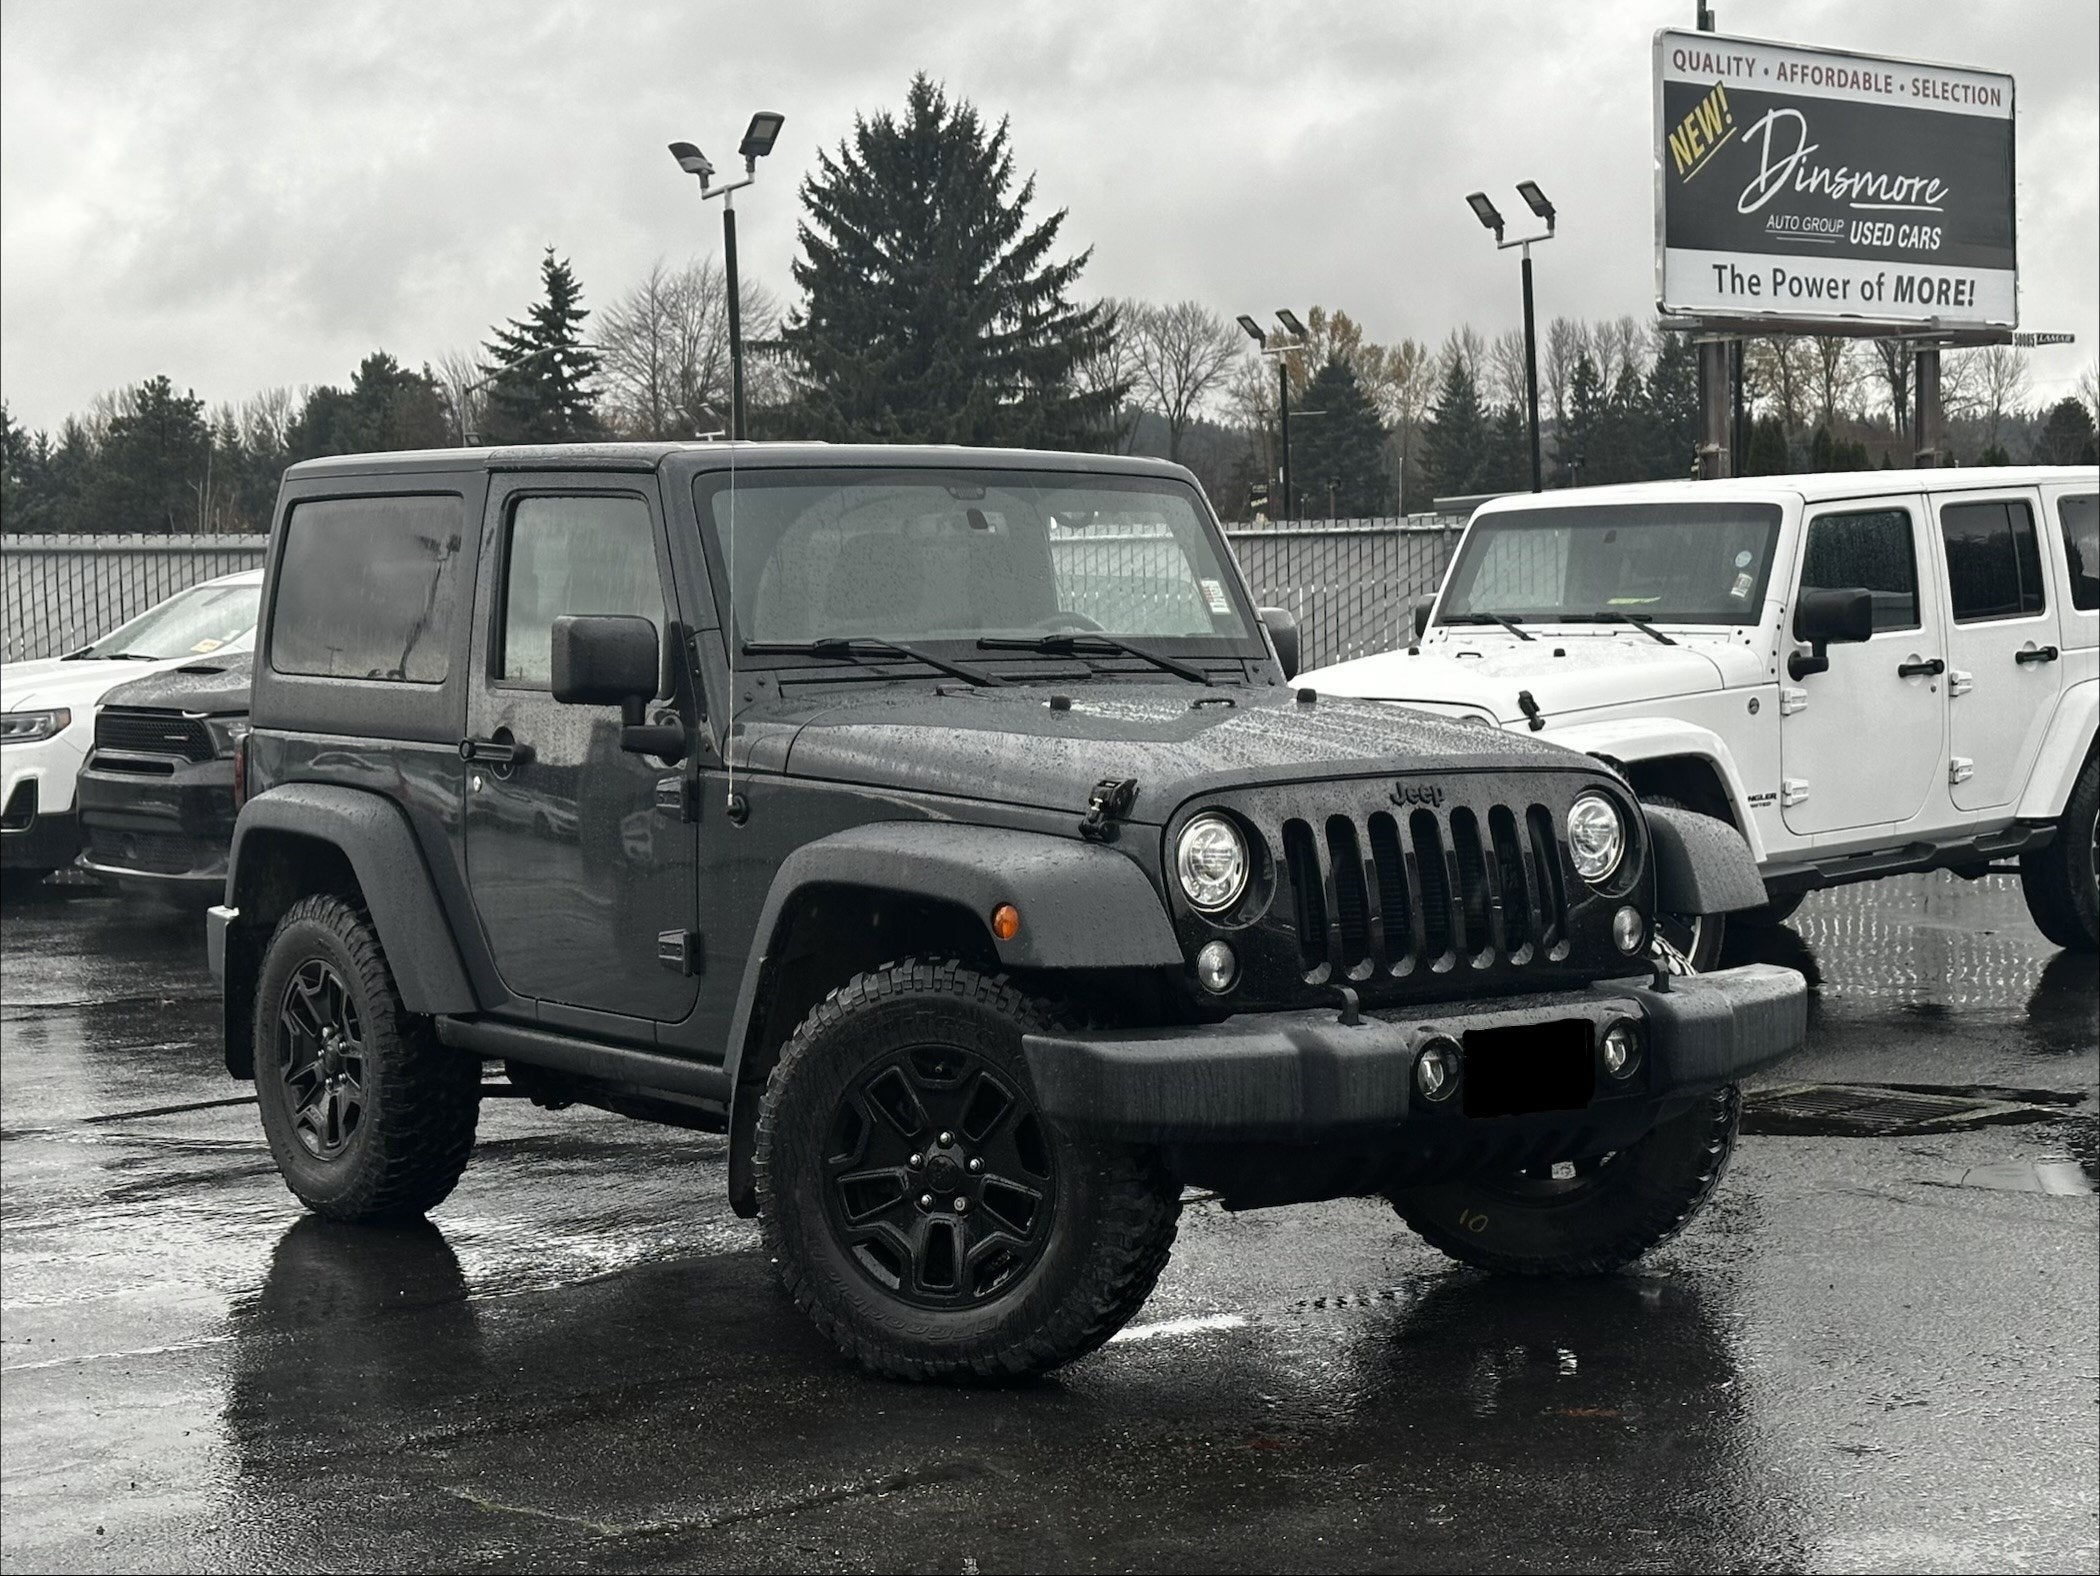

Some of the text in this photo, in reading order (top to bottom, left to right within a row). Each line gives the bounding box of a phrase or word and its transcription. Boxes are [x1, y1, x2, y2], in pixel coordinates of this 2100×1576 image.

[1672, 49, 2001, 107] QUALITY AFFORDABLE SELECTION
[1668, 82, 1733, 176] NEW!
[1736, 108, 1949, 213] Dinsmore
[1766, 214, 1942, 251] AUTO GROUP USED CARS
[1712, 263, 1976, 307] The Power of MORE!
[1389, 781, 1446, 808] Jeep
[1747, 792, 1777, 802] NGLER
